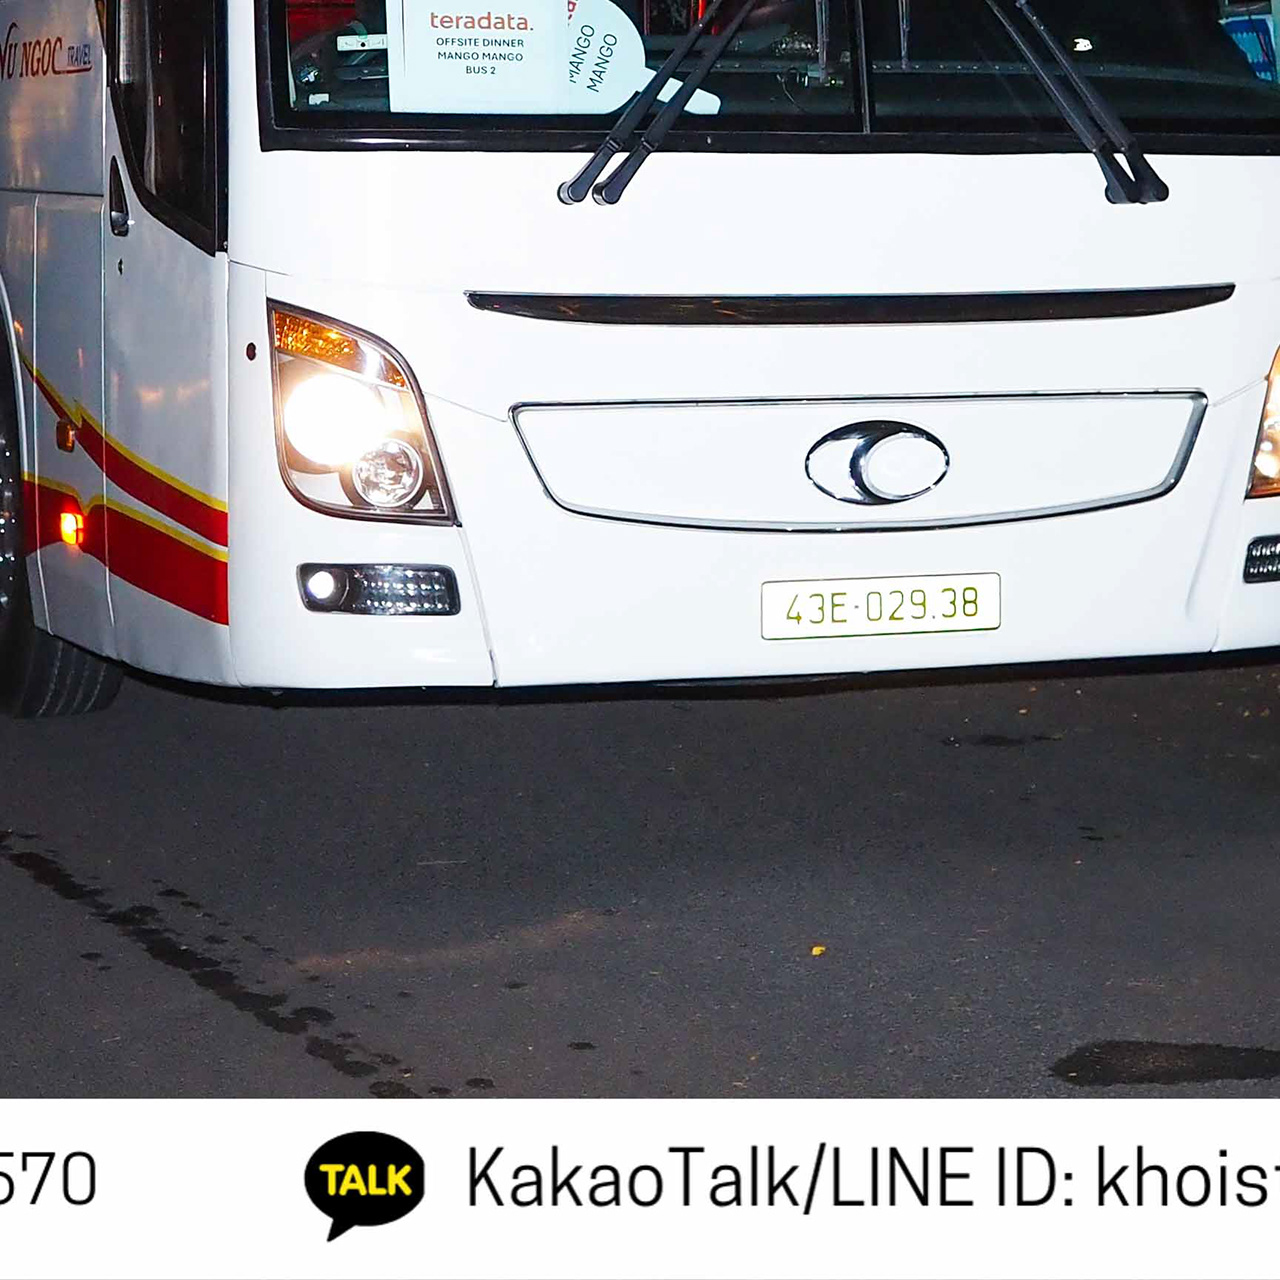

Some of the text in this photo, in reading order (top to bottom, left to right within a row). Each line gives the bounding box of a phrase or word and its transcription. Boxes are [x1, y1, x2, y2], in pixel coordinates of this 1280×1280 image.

[430, 11, 534, 32] teradata.
[19, 36, 63, 78] NGOC
[67, 43, 91, 66] TRAVEL
[436, 37, 524, 48] OFFSITE DINNER
[437, 51, 524, 62] MANGO MANGO
[569, 24, 595, 84] MANGO
[465, 65, 496, 75] BUS 2
[587, 33, 618, 93] MANGO
[785, 586, 979, 625] 43E-029.38
